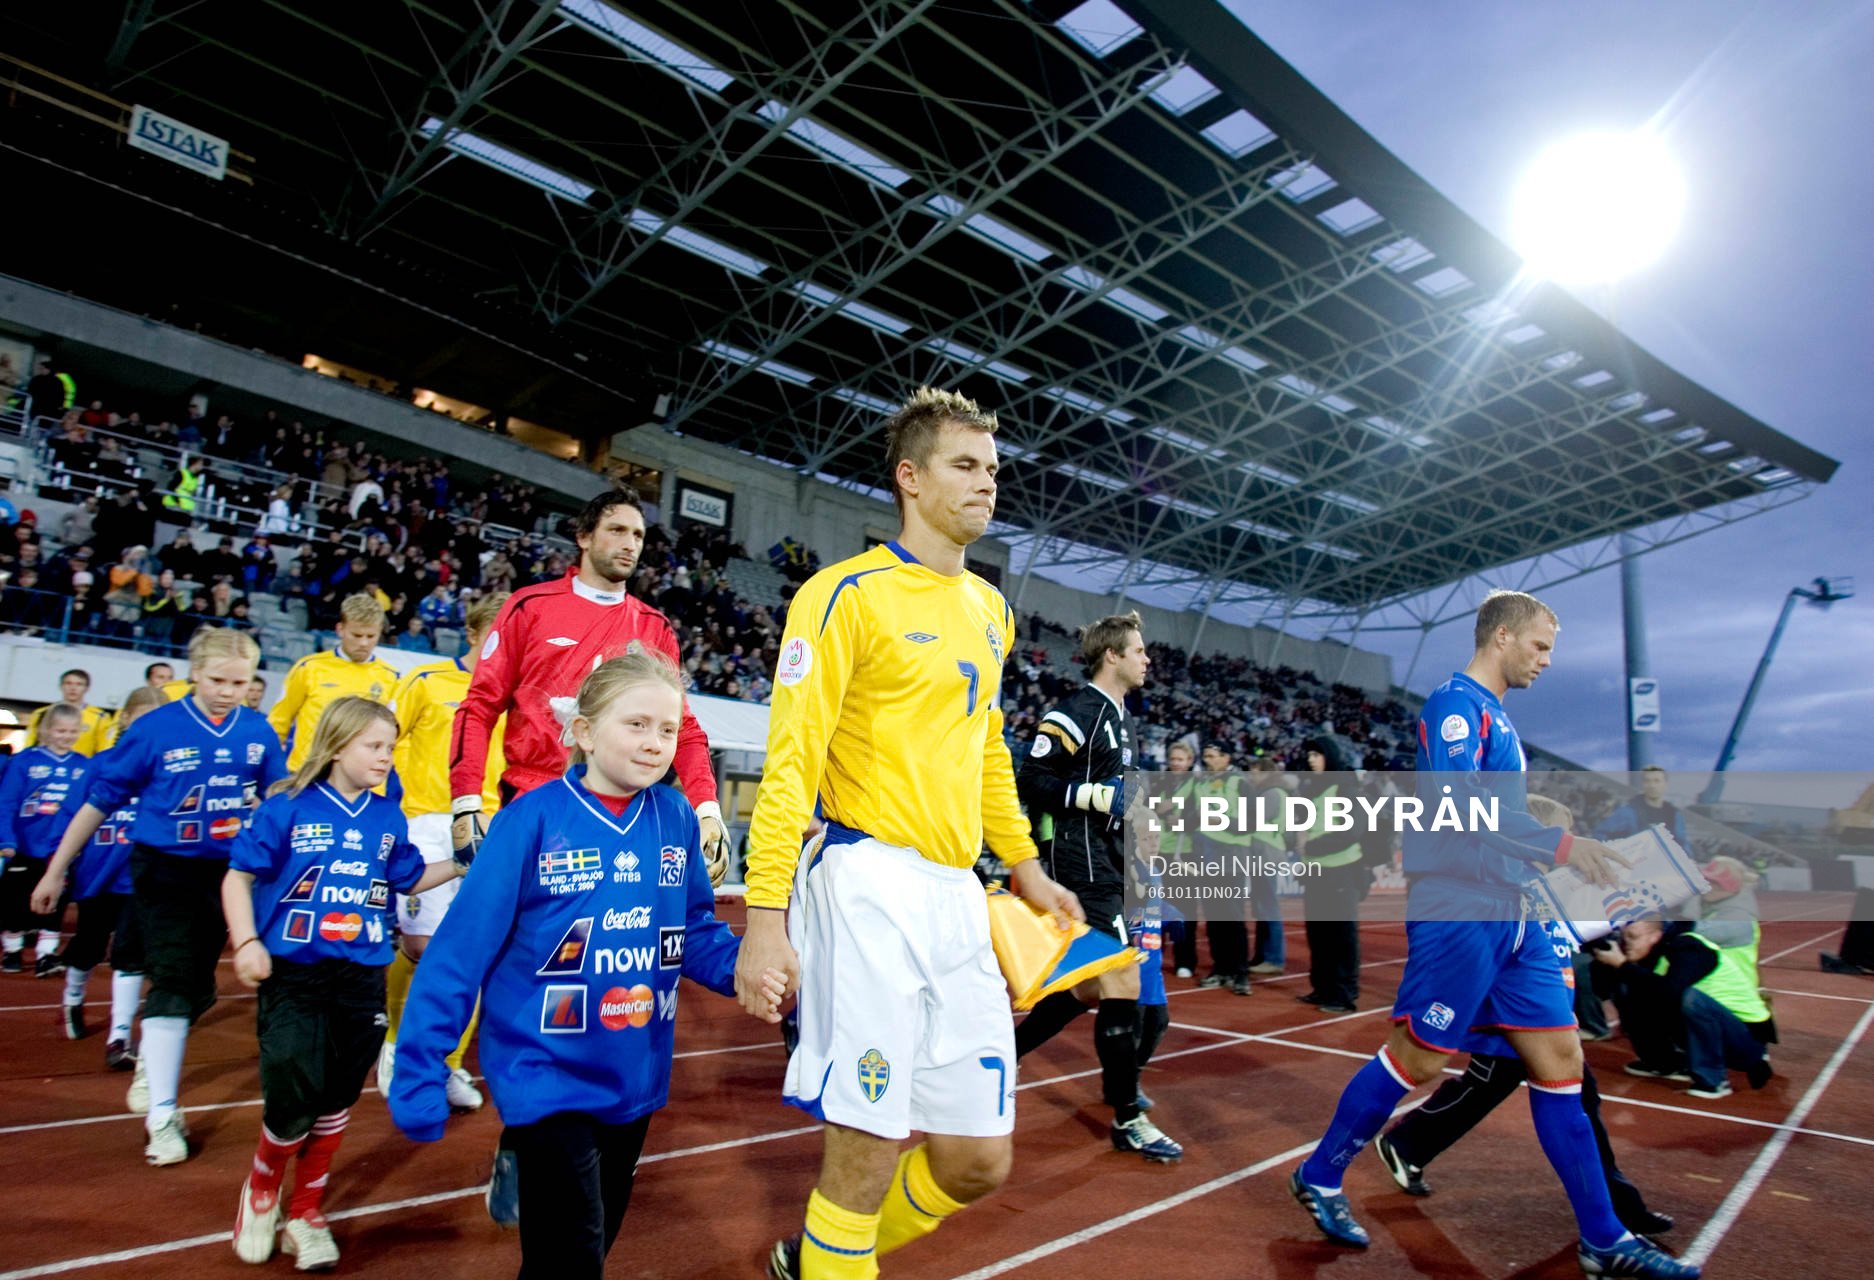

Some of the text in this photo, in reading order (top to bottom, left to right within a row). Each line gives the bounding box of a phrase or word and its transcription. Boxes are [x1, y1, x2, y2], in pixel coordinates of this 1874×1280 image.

[137, 111, 220, 163] ÍSTAK
[956, 659, 980, 717] 7
[1104, 720, 1119, 749] 1
[613, 871, 641, 884] errea
[321, 886, 369, 905] now
[1112, 914, 1129, 945] 1
[595, 946, 656, 975] now
[663, 934, 686, 958] 1X
[600, 999, 654, 1017] MasterCard
[979, 1056, 1006, 1117] 7
